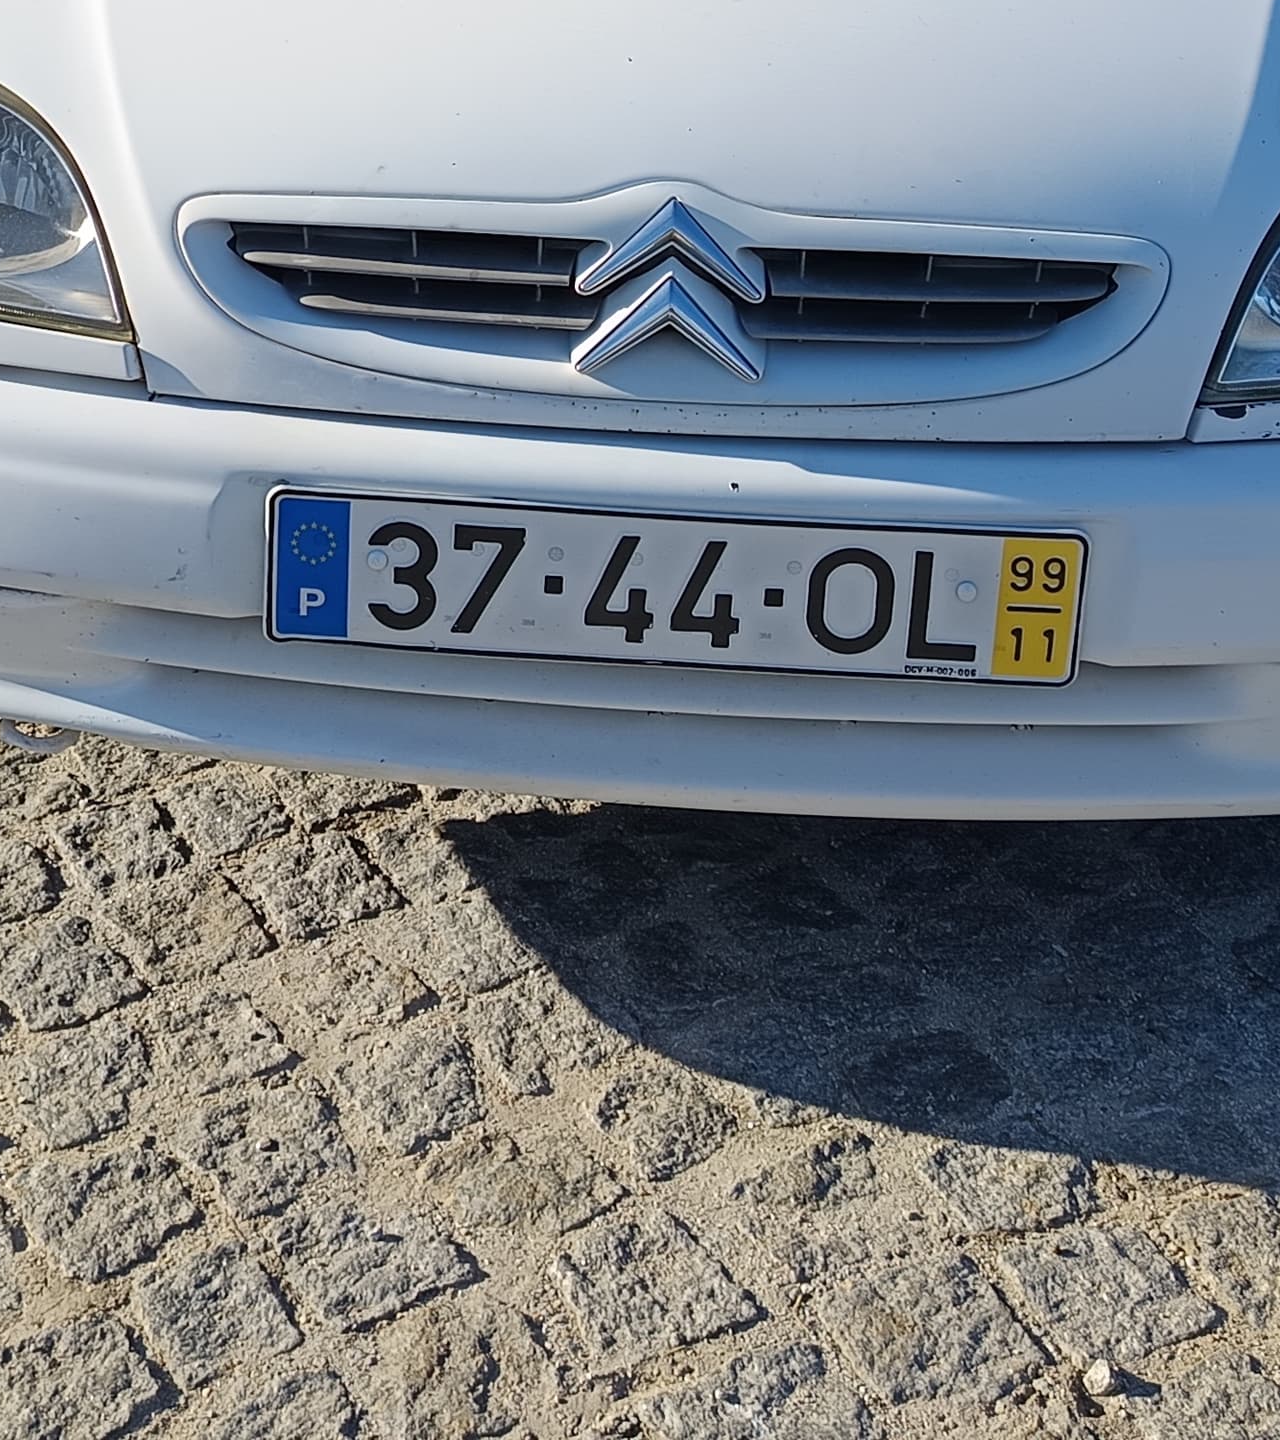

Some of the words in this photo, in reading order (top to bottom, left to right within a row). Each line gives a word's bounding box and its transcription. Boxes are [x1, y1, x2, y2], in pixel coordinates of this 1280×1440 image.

[1009, 556, 1066, 593] 99
[299, 588, 325, 616] P
[1010, 627, 1056, 662] 11
